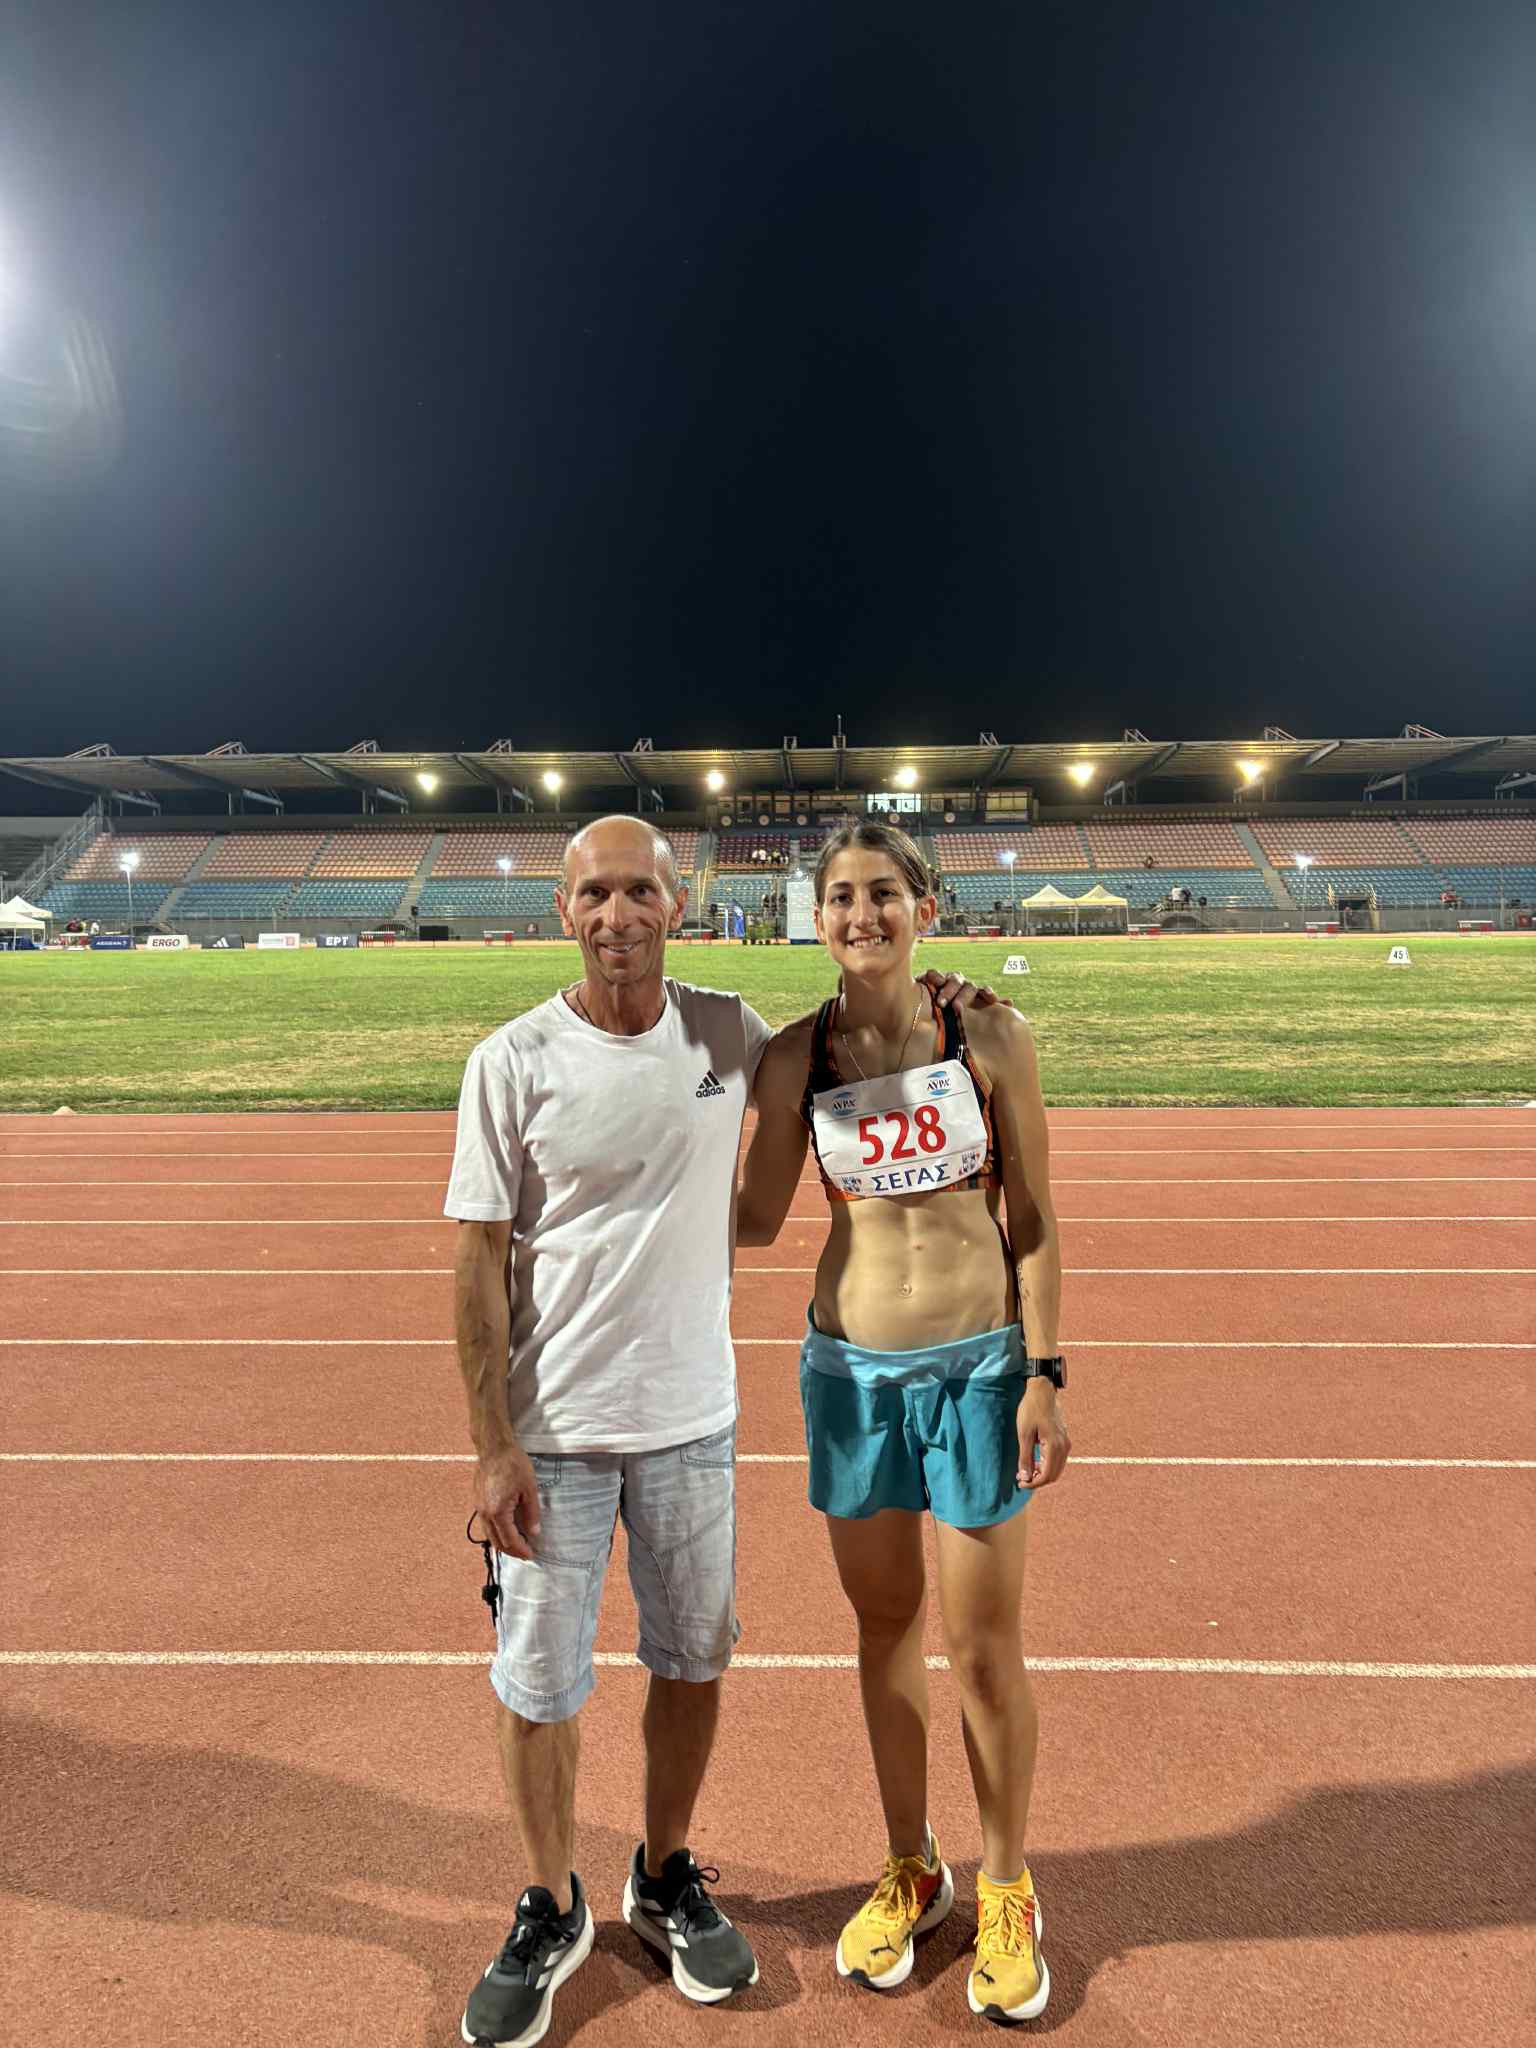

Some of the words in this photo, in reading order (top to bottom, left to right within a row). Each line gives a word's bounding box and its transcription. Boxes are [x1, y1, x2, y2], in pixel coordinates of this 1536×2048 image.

[152, 938, 180, 947] ERGO
[1393, 950, 1404, 960] 45
[1007, 960, 1018, 970] 55
[695, 1086, 726, 1098] adidas
[858, 1104, 947, 1165] 528
[871, 1163, 951, 1192] ΣΕΓΑΣ
